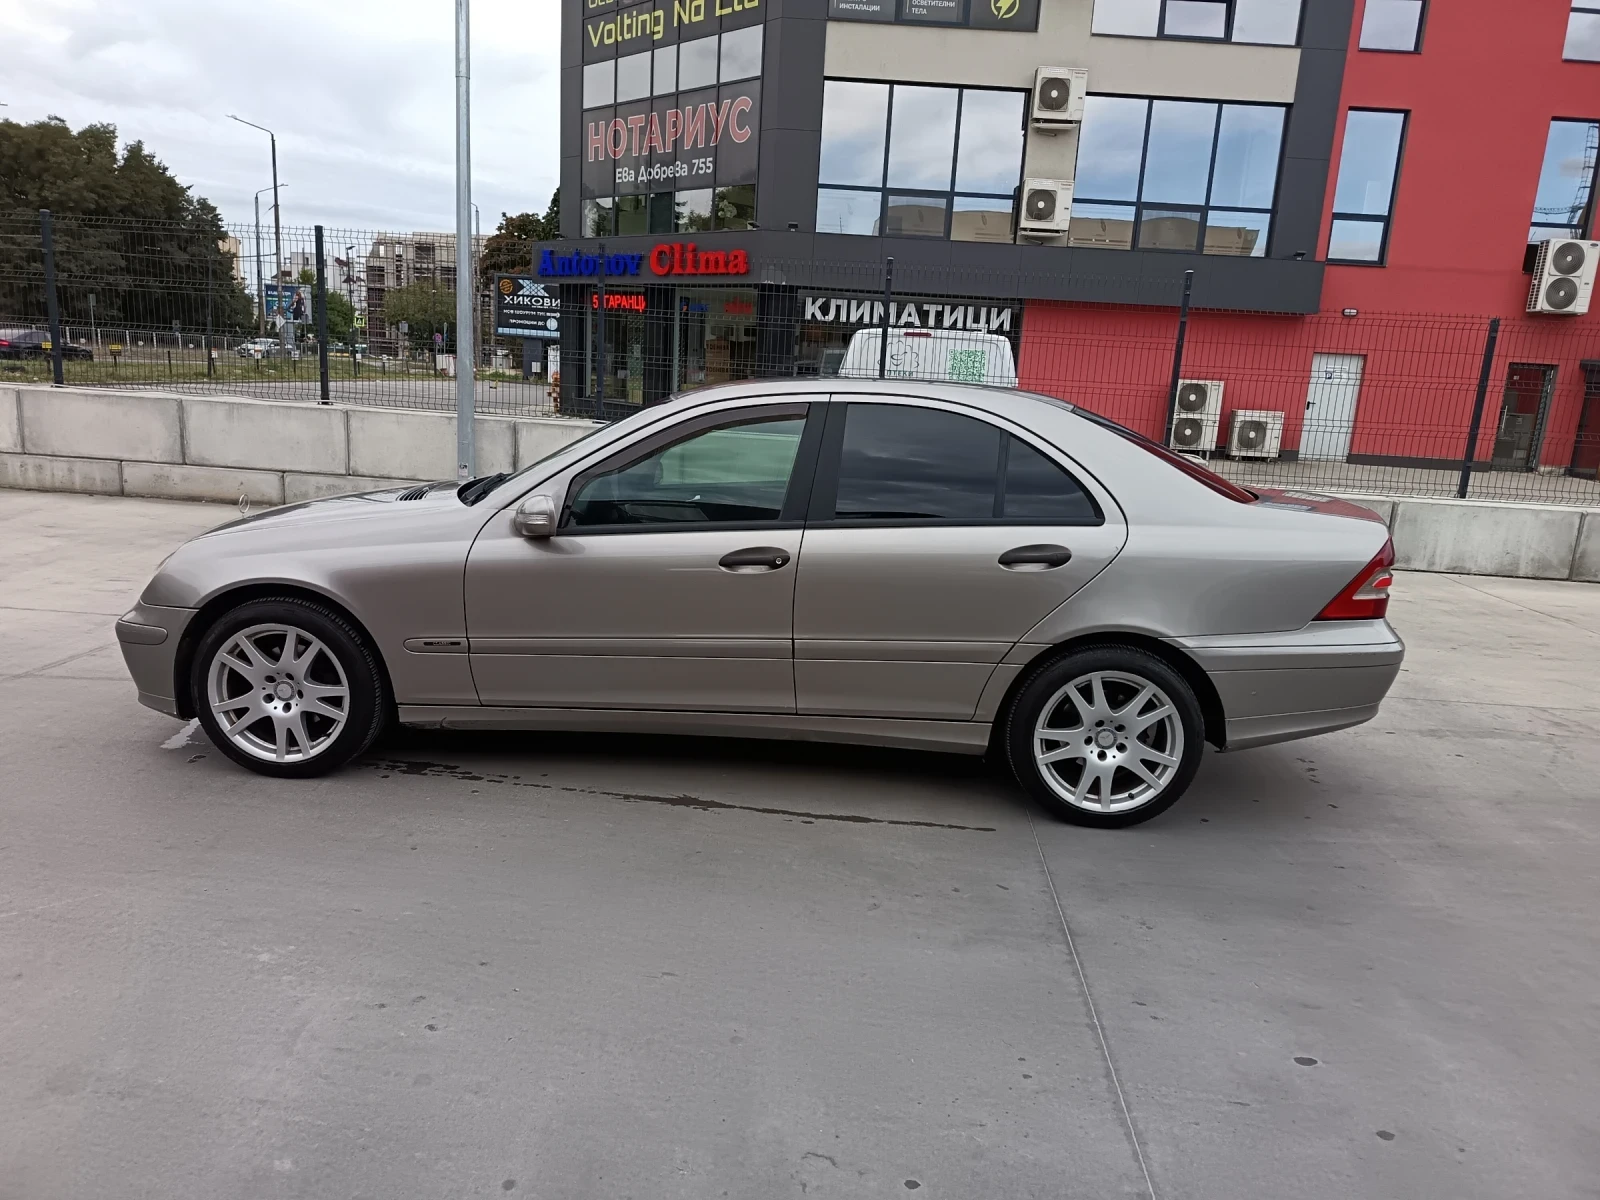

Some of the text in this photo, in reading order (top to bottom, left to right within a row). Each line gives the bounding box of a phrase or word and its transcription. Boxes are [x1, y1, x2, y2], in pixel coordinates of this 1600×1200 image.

[839, 3, 880, 12] ИНСТАЛАЦИИ
[912, 0, 955, 8] ОСВЕТИТЕЛНИ
[588, 9, 664, 47] Volting
[588, 96, 752, 162] НОТАРИУС
[691, 157, 713, 174] 755
[650, 243, 748, 275] Clima
[504, 295, 560, 306] ХИКОВИ
[592, 294, 599, 309] 5
[804, 296, 1012, 334] КЛИМАТИЦИ
[883, 369, 914, 377] ПТЕКИ
